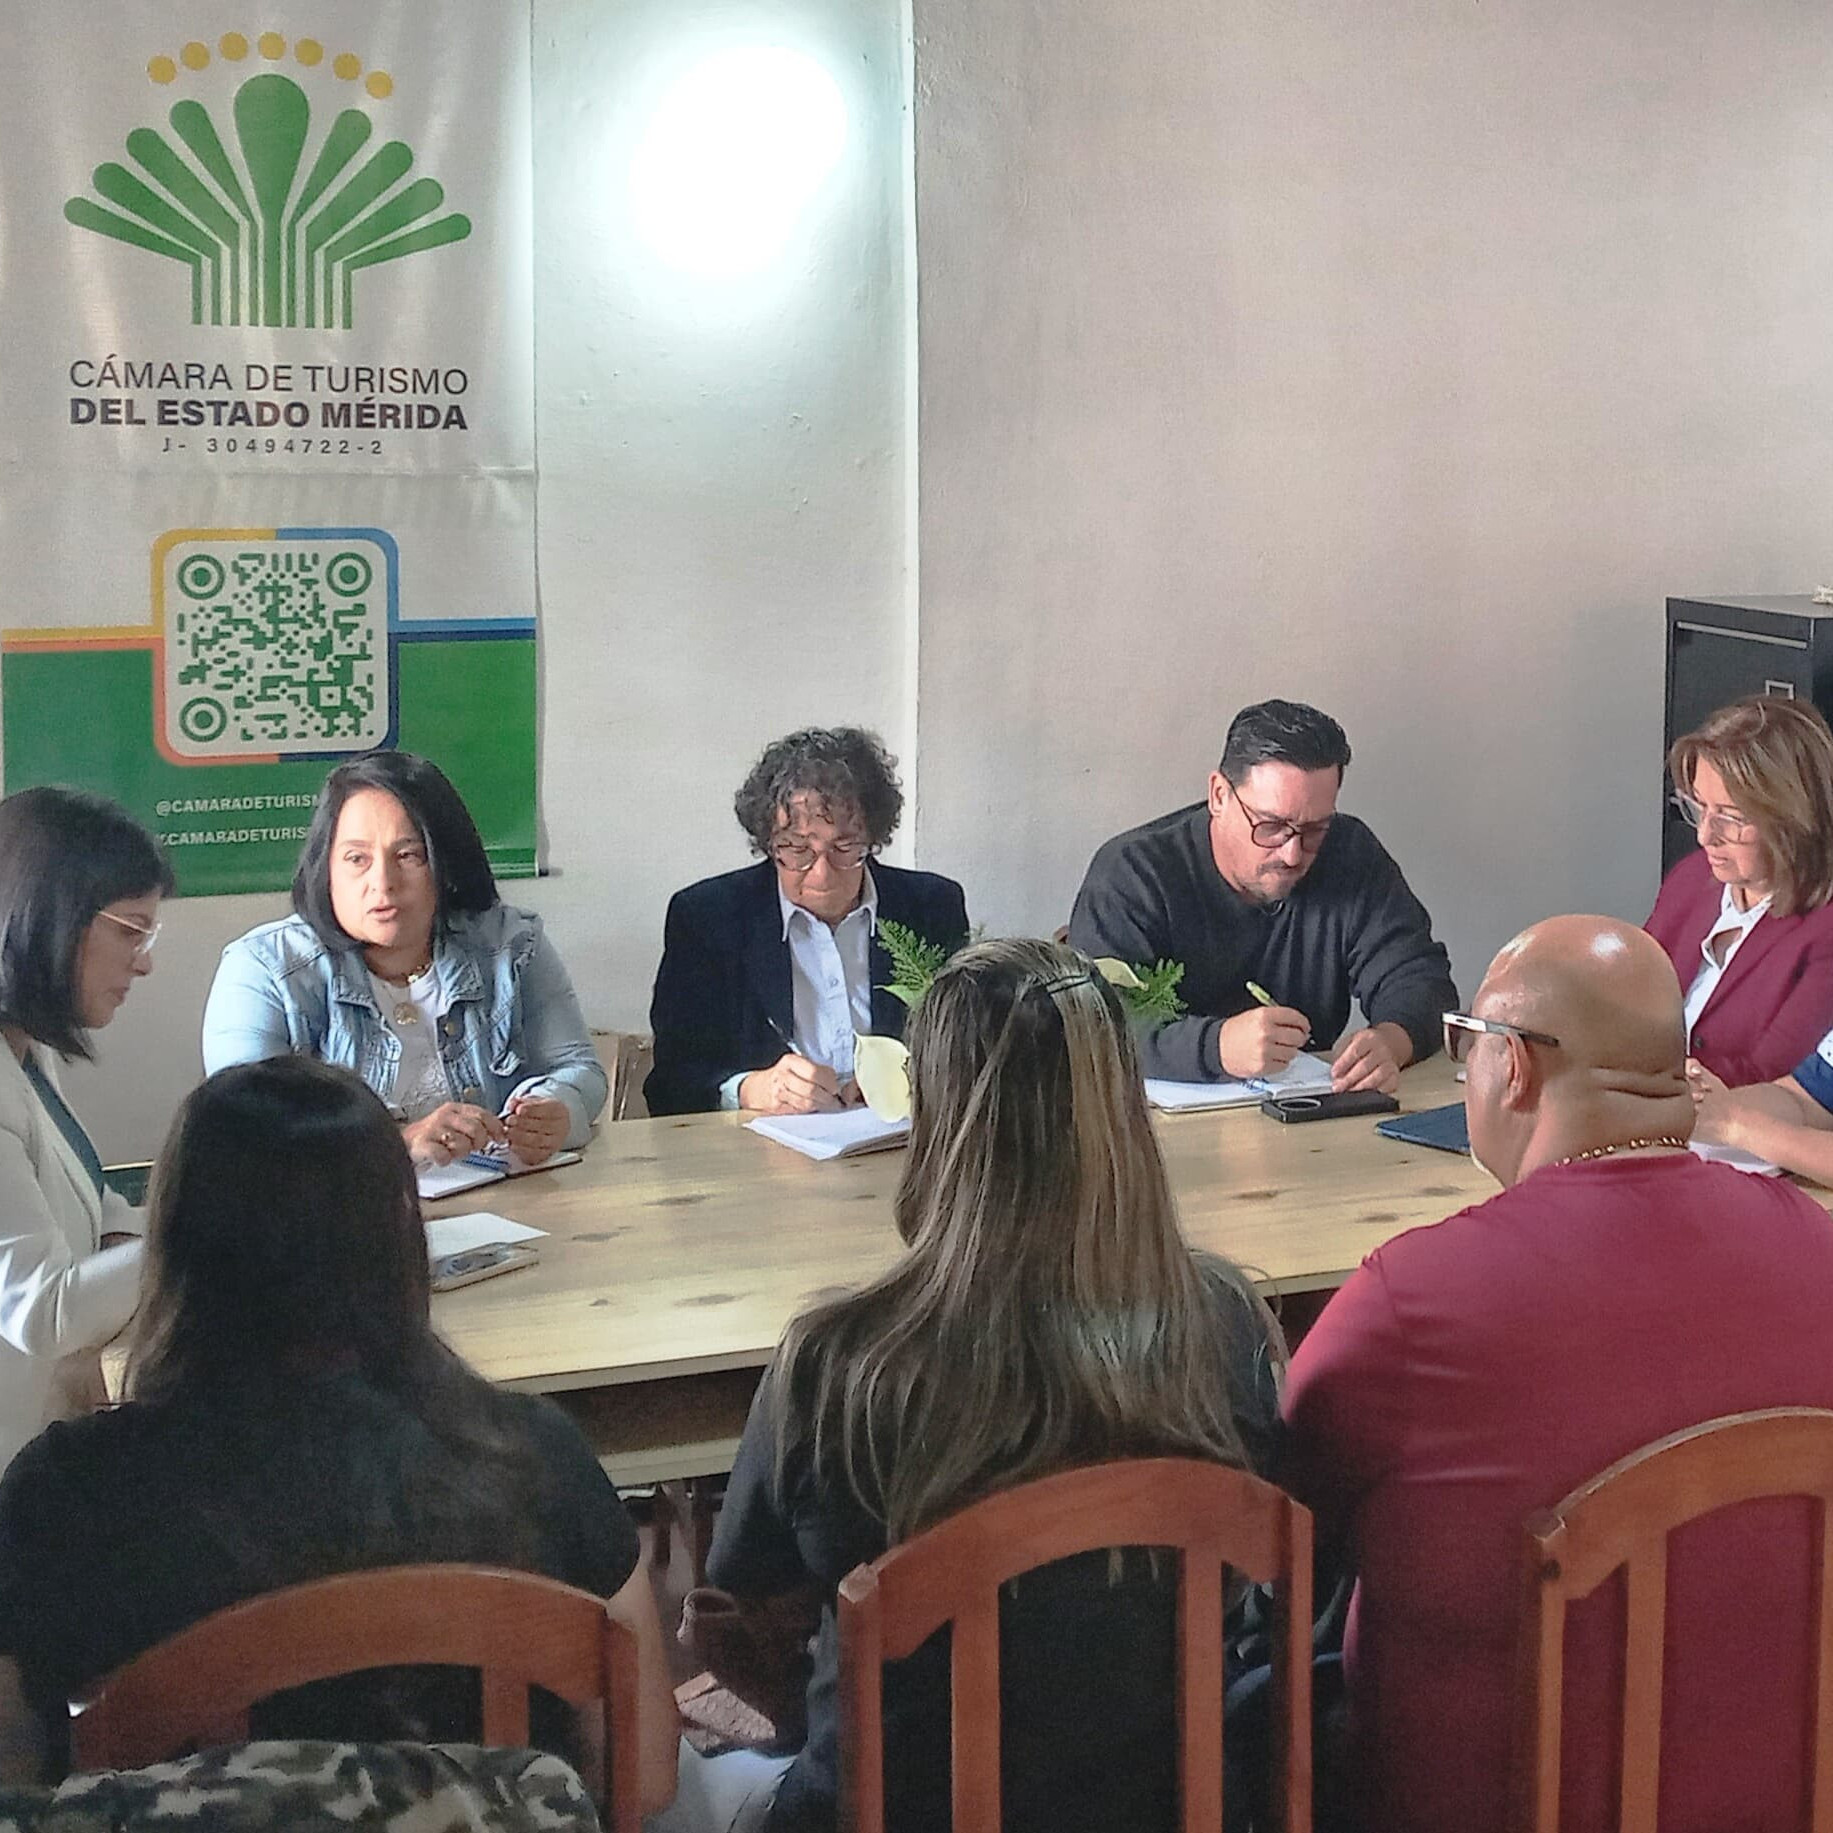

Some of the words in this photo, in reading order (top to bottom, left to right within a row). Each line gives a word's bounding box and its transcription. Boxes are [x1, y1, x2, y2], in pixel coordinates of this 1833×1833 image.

[69, 353, 234, 391] CÁMARA
[245, 364, 294, 392] DE
[302, 365, 469, 396] TURISMO
[69, 398, 147, 426] DEL
[156, 398, 311, 429] ESTADO
[320, 396, 469, 431] MÉRIDA
